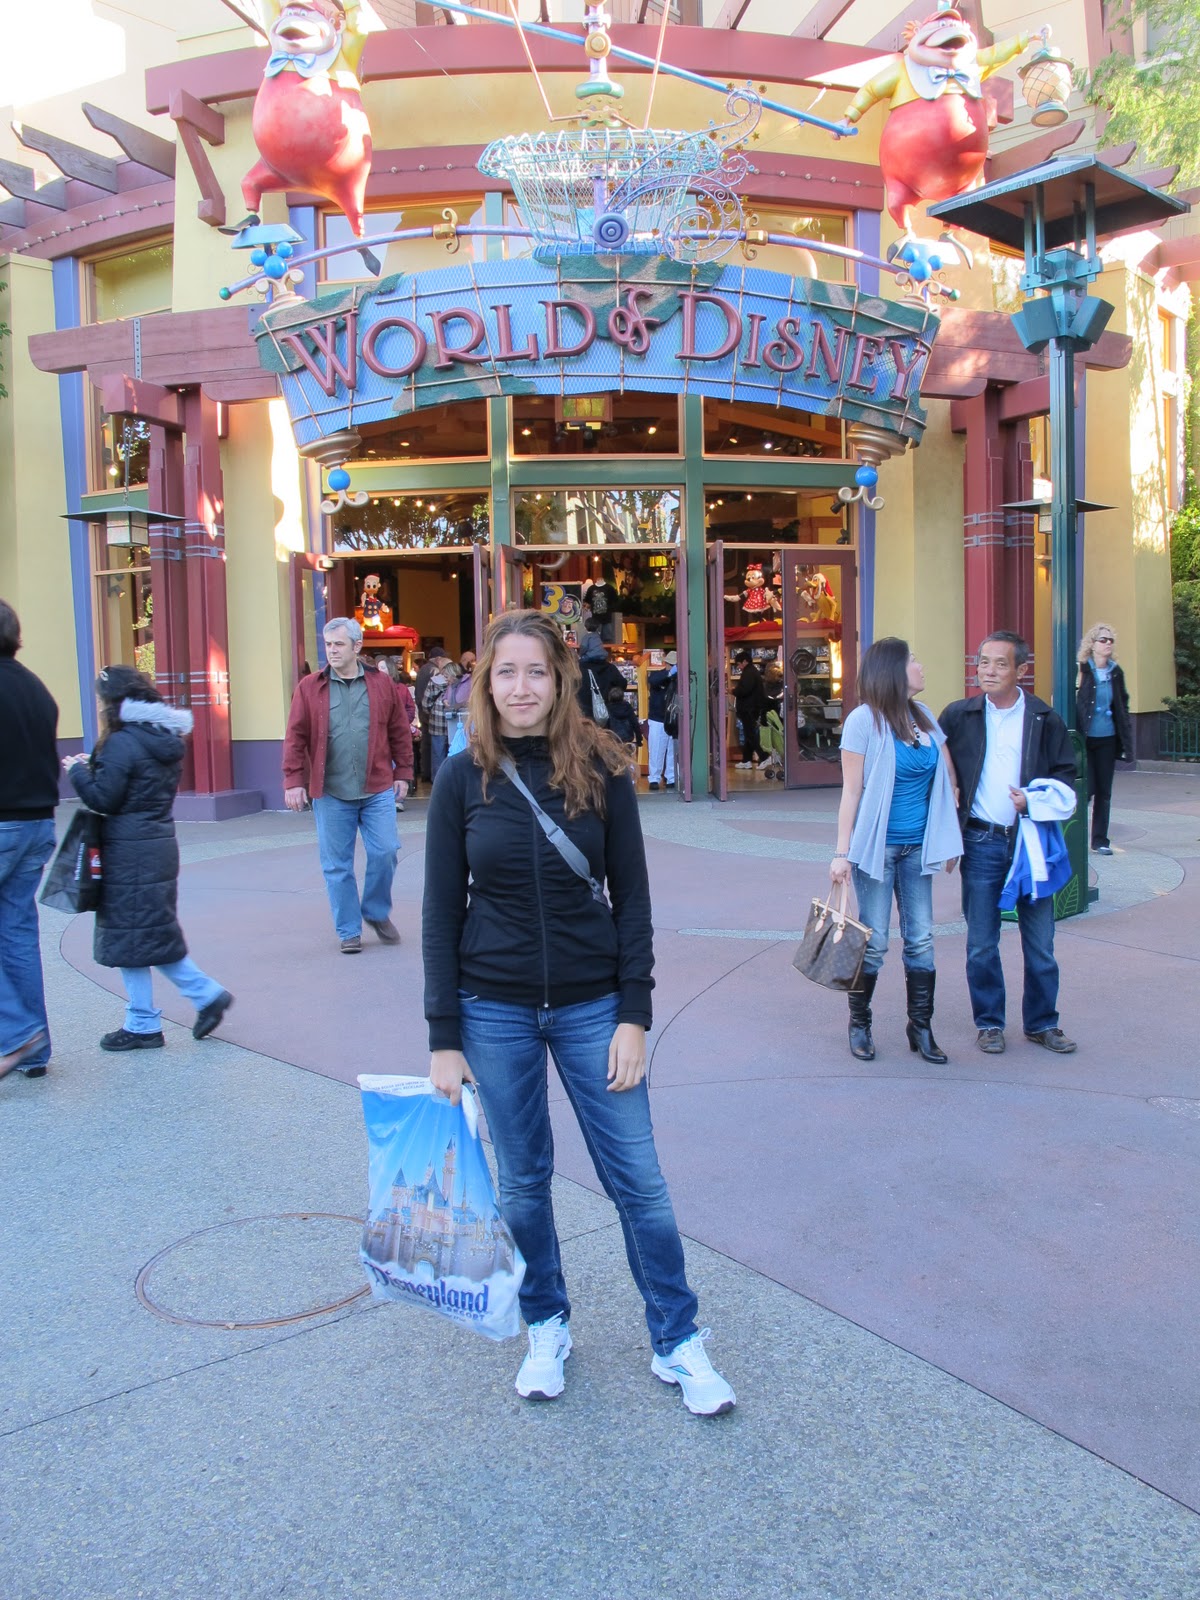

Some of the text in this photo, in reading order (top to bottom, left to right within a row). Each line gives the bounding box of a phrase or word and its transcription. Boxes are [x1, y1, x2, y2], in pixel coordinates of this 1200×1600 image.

[281, 300, 597, 397] WORLD
[675, 290, 926, 400] DISNEY
[541, 584, 565, 614] 3
[363, 1260, 489, 1313] Disneyland
